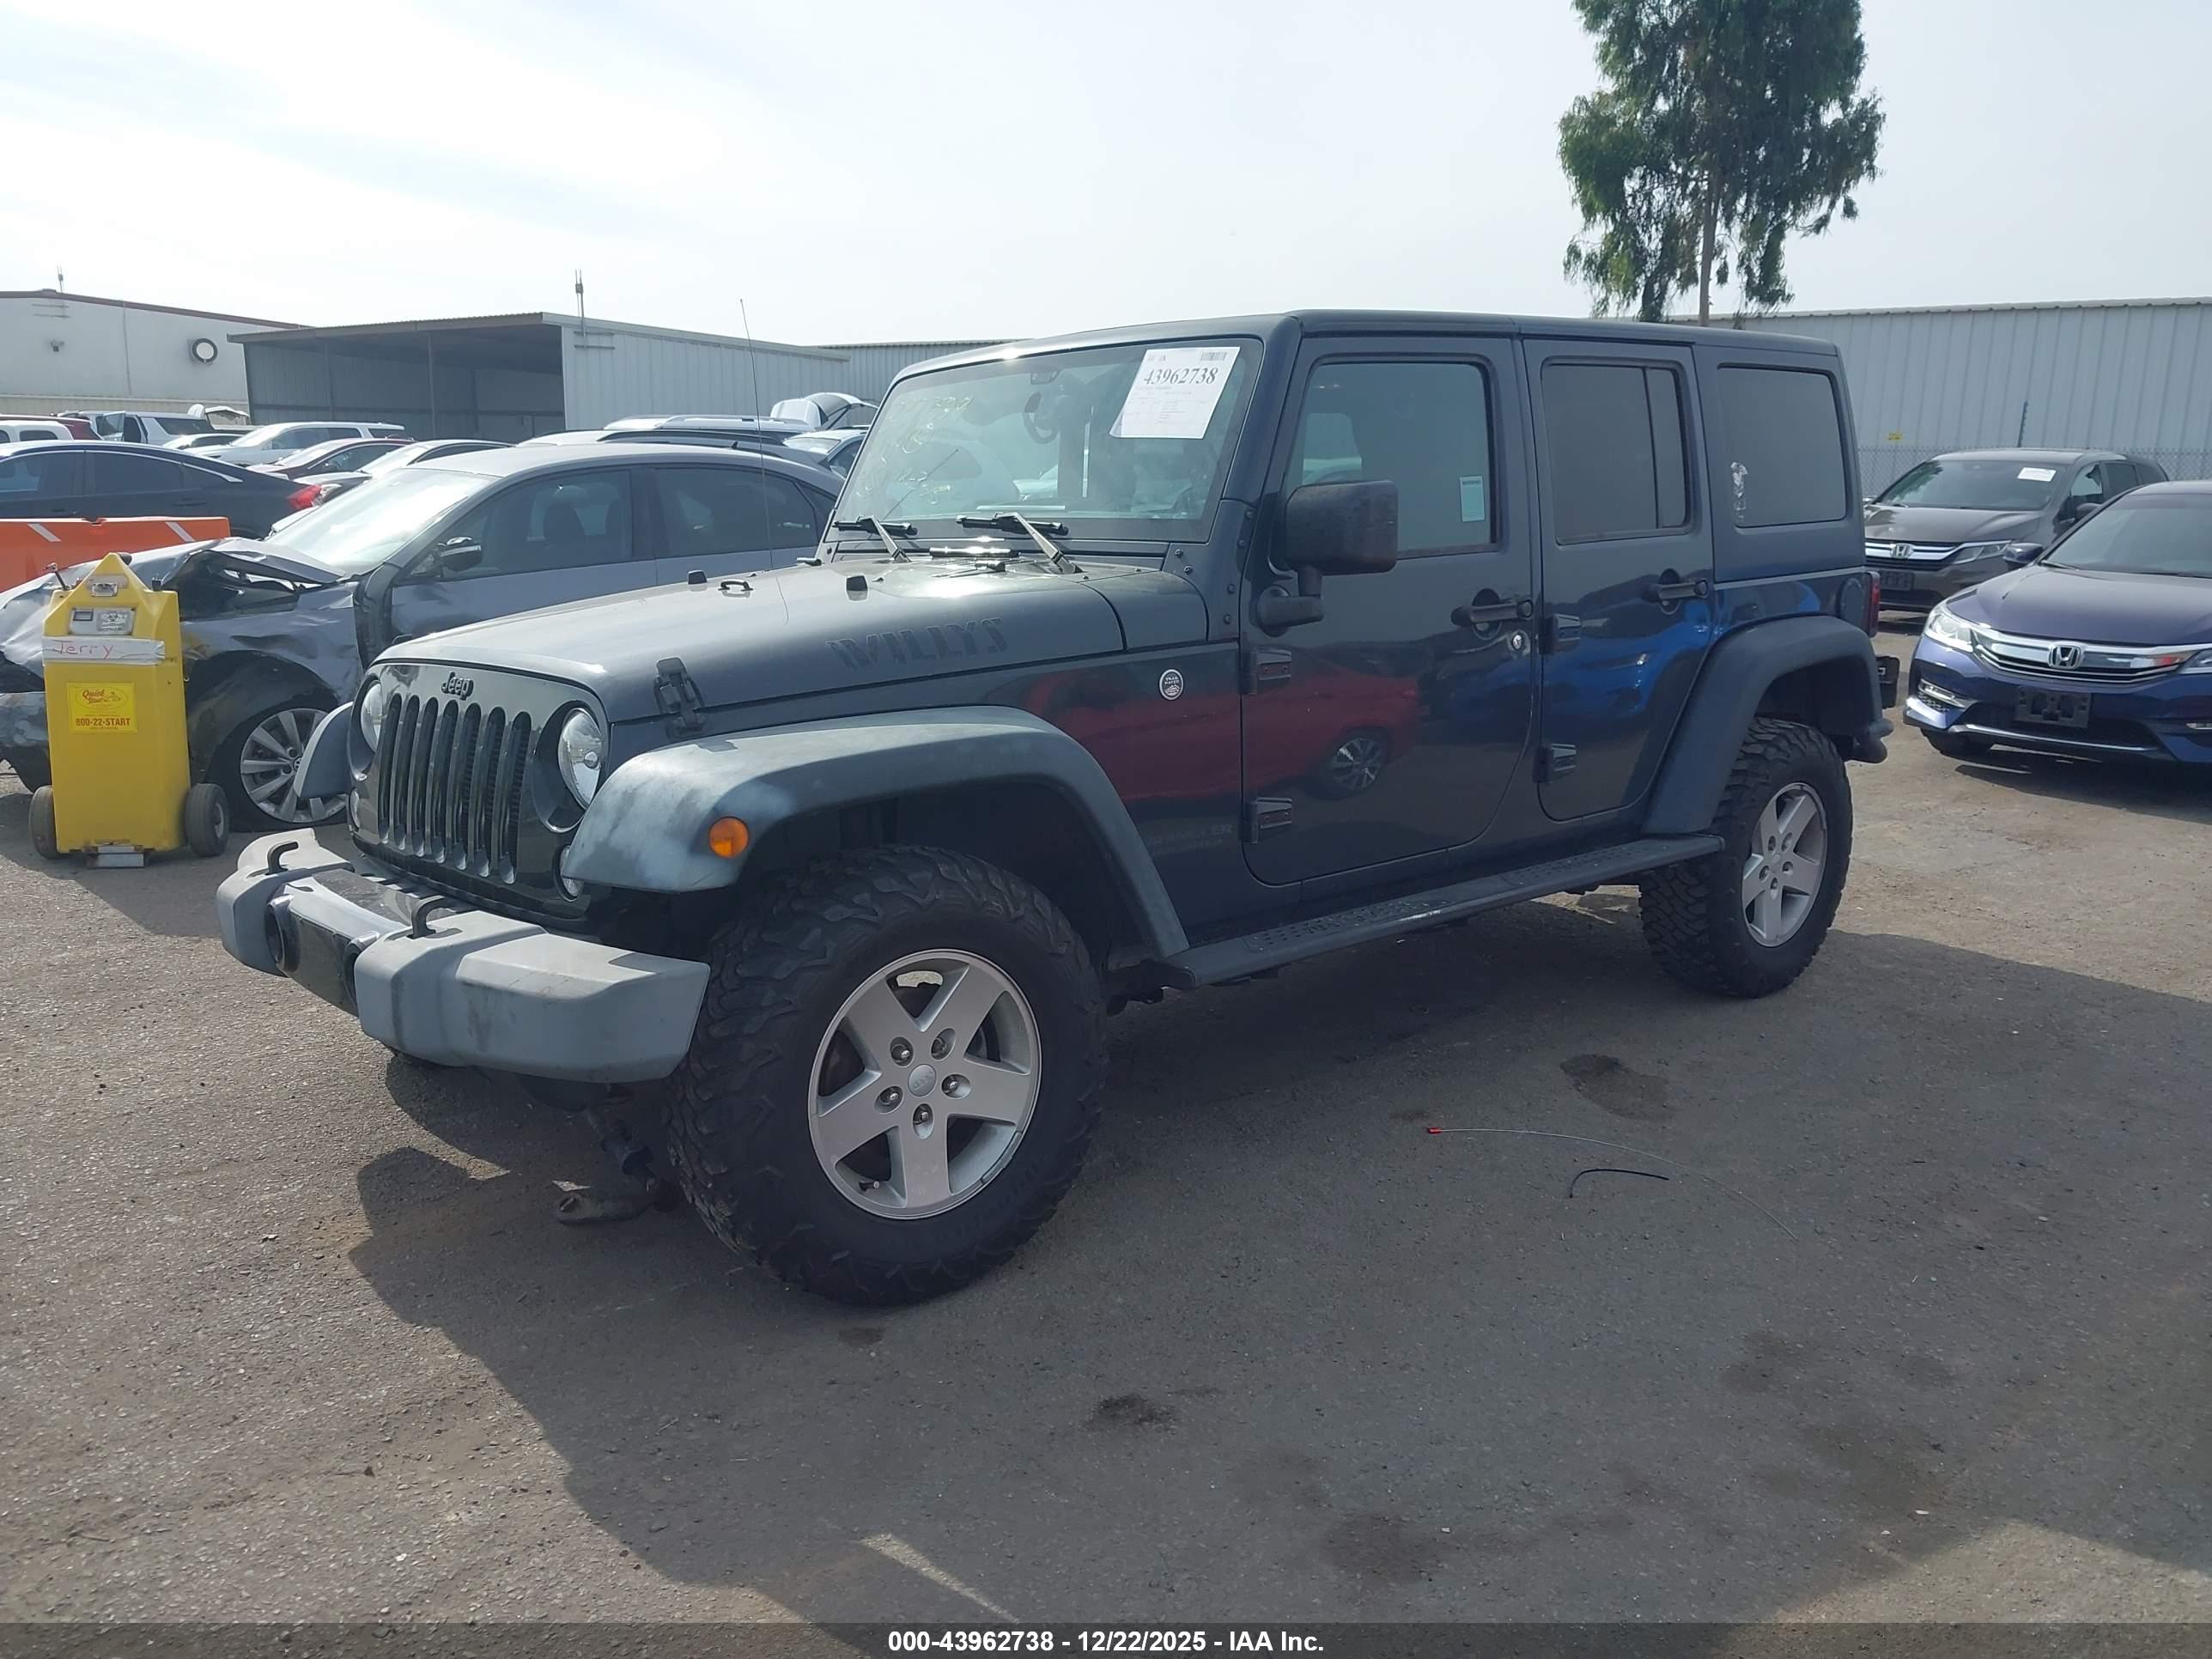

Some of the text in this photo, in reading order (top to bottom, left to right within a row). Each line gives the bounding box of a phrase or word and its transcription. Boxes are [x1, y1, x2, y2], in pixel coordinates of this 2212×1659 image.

[1144, 367, 1219, 386] 43962738
[52, 640, 114, 659] Jerry
[441, 672, 474, 701] Jeep
